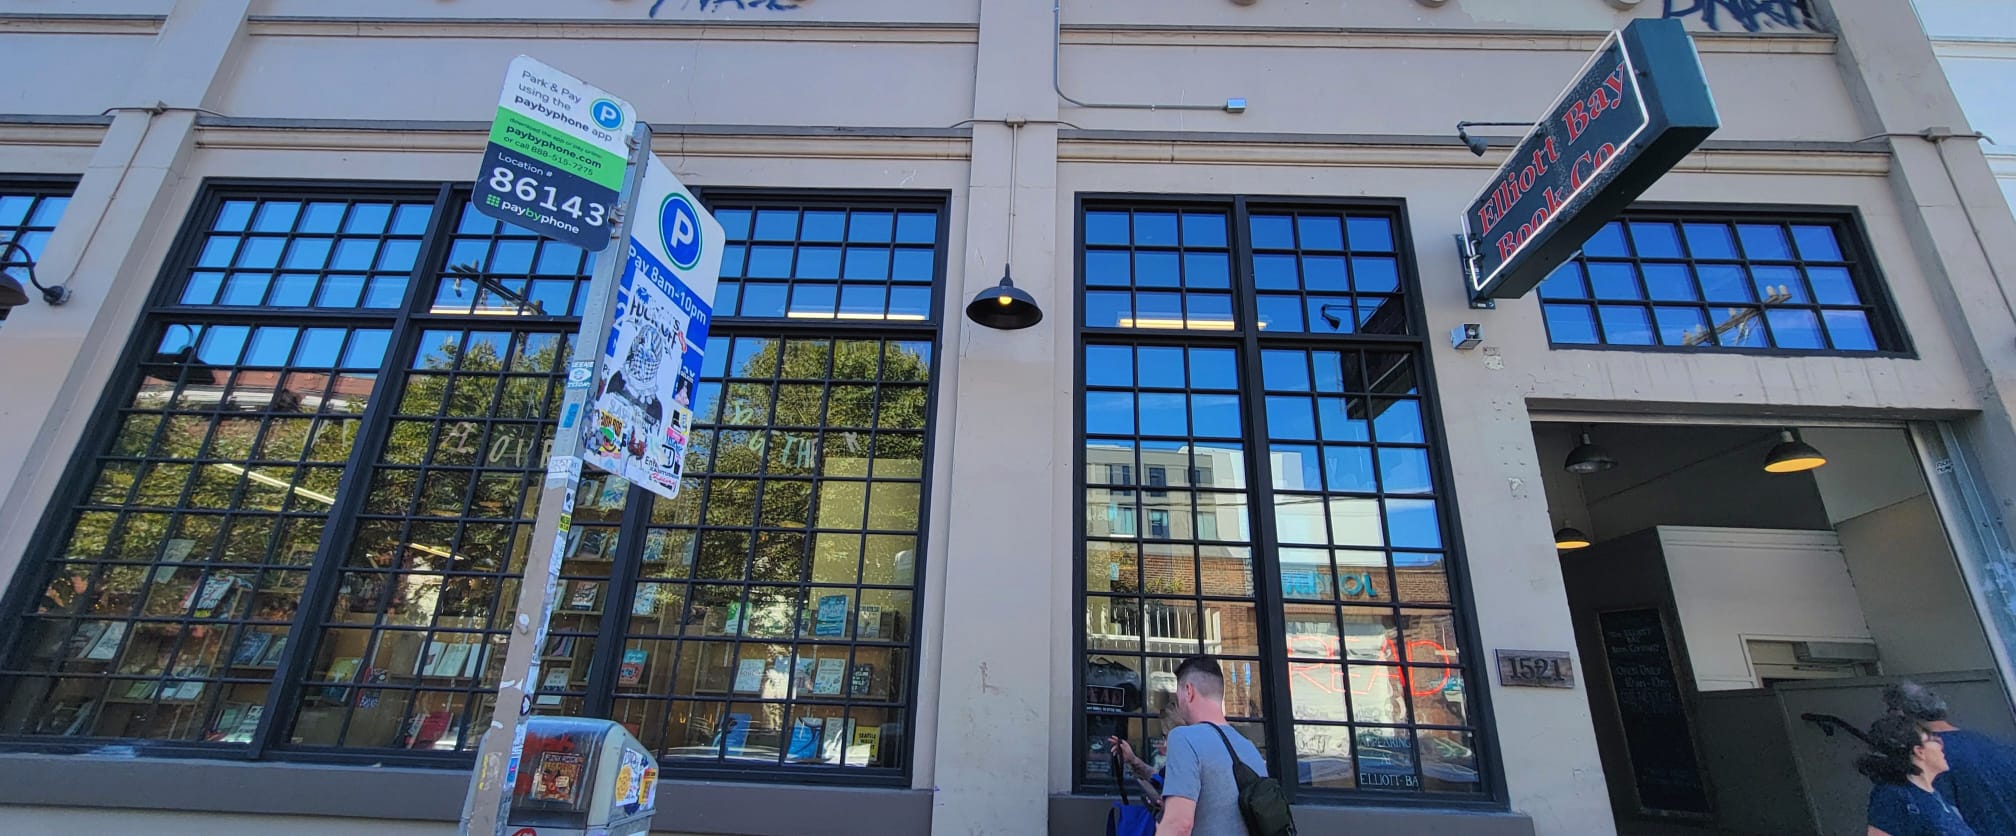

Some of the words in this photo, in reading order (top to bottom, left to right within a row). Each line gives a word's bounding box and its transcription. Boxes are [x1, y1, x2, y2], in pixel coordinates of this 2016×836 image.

[518, 83, 550, 104] using
[552, 96, 571, 111] the
[521, 70, 548, 88] Park
[550, 83, 559, 93] &
[561, 88, 582, 104] Pay
[514, 95, 589, 133] paybyphone
[592, 129, 613, 143] app
[599, 105, 617, 122] P
[498, 152, 544, 176] Location
[503, 136, 514, 144] or
[514, 140, 530, 151] call
[531, 145, 594, 176] 888-515-7275
[506, 125, 602, 169] paybyphone.com
[1477, 135, 1560, 238] Elliott
[1562, 62, 1626, 146] Bay
[489, 167, 606, 227] 86143
[502, 200, 580, 234] paybyphone
[1495, 185, 1565, 266] Book
[1570, 142, 1628, 194] Co.
[670, 207, 694, 249] P
[627, 248, 650, 272] Pay
[651, 266, 706, 325] 8am-10pm
[1286, 636, 1450, 697] READ
[1508, 656, 1565, 681] 1521
